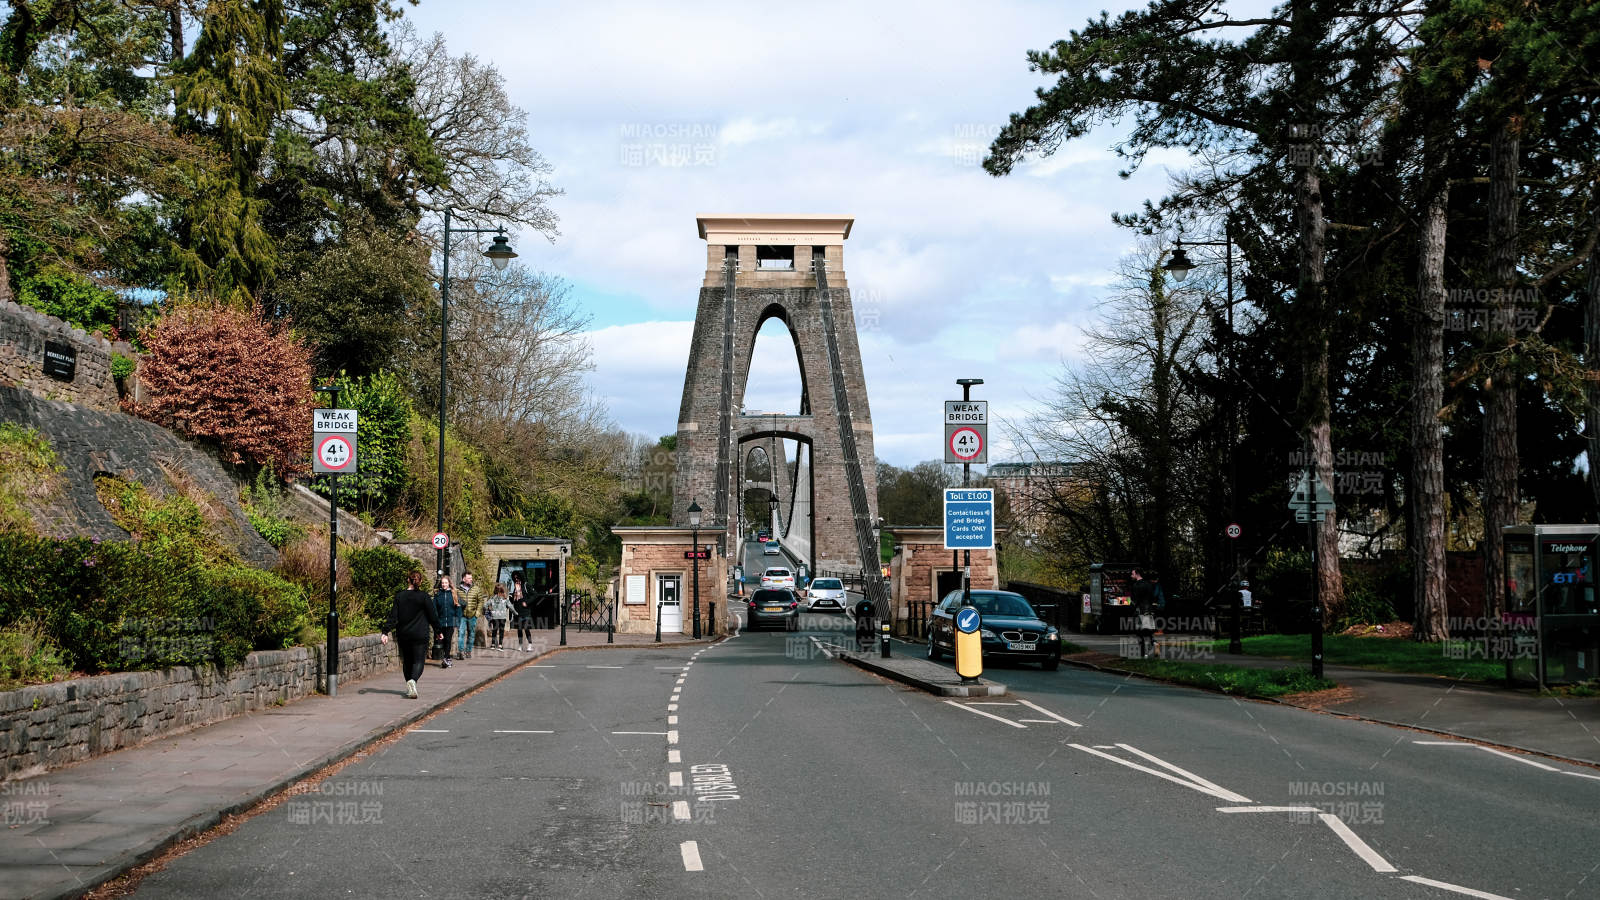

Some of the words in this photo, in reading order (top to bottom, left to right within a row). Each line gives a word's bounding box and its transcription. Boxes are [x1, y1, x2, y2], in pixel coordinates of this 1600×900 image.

[952, 404, 980, 412] WEAK
[322, 412, 350, 420] WEAK
[948, 413, 984, 421] BRIDGE
[317, 421, 354, 429] BRIDGE
[950, 492, 964, 500] Toll
[967, 492, 988, 500] £1.00
[966, 517, 985, 525] Bridge
[1228, 527, 1240, 535] 20
[434, 537, 446, 545] 20
[1550, 543, 1588, 554] Telephone
[1553, 572, 1577, 584] BT
[691, 763, 741, 802] DISABLED
